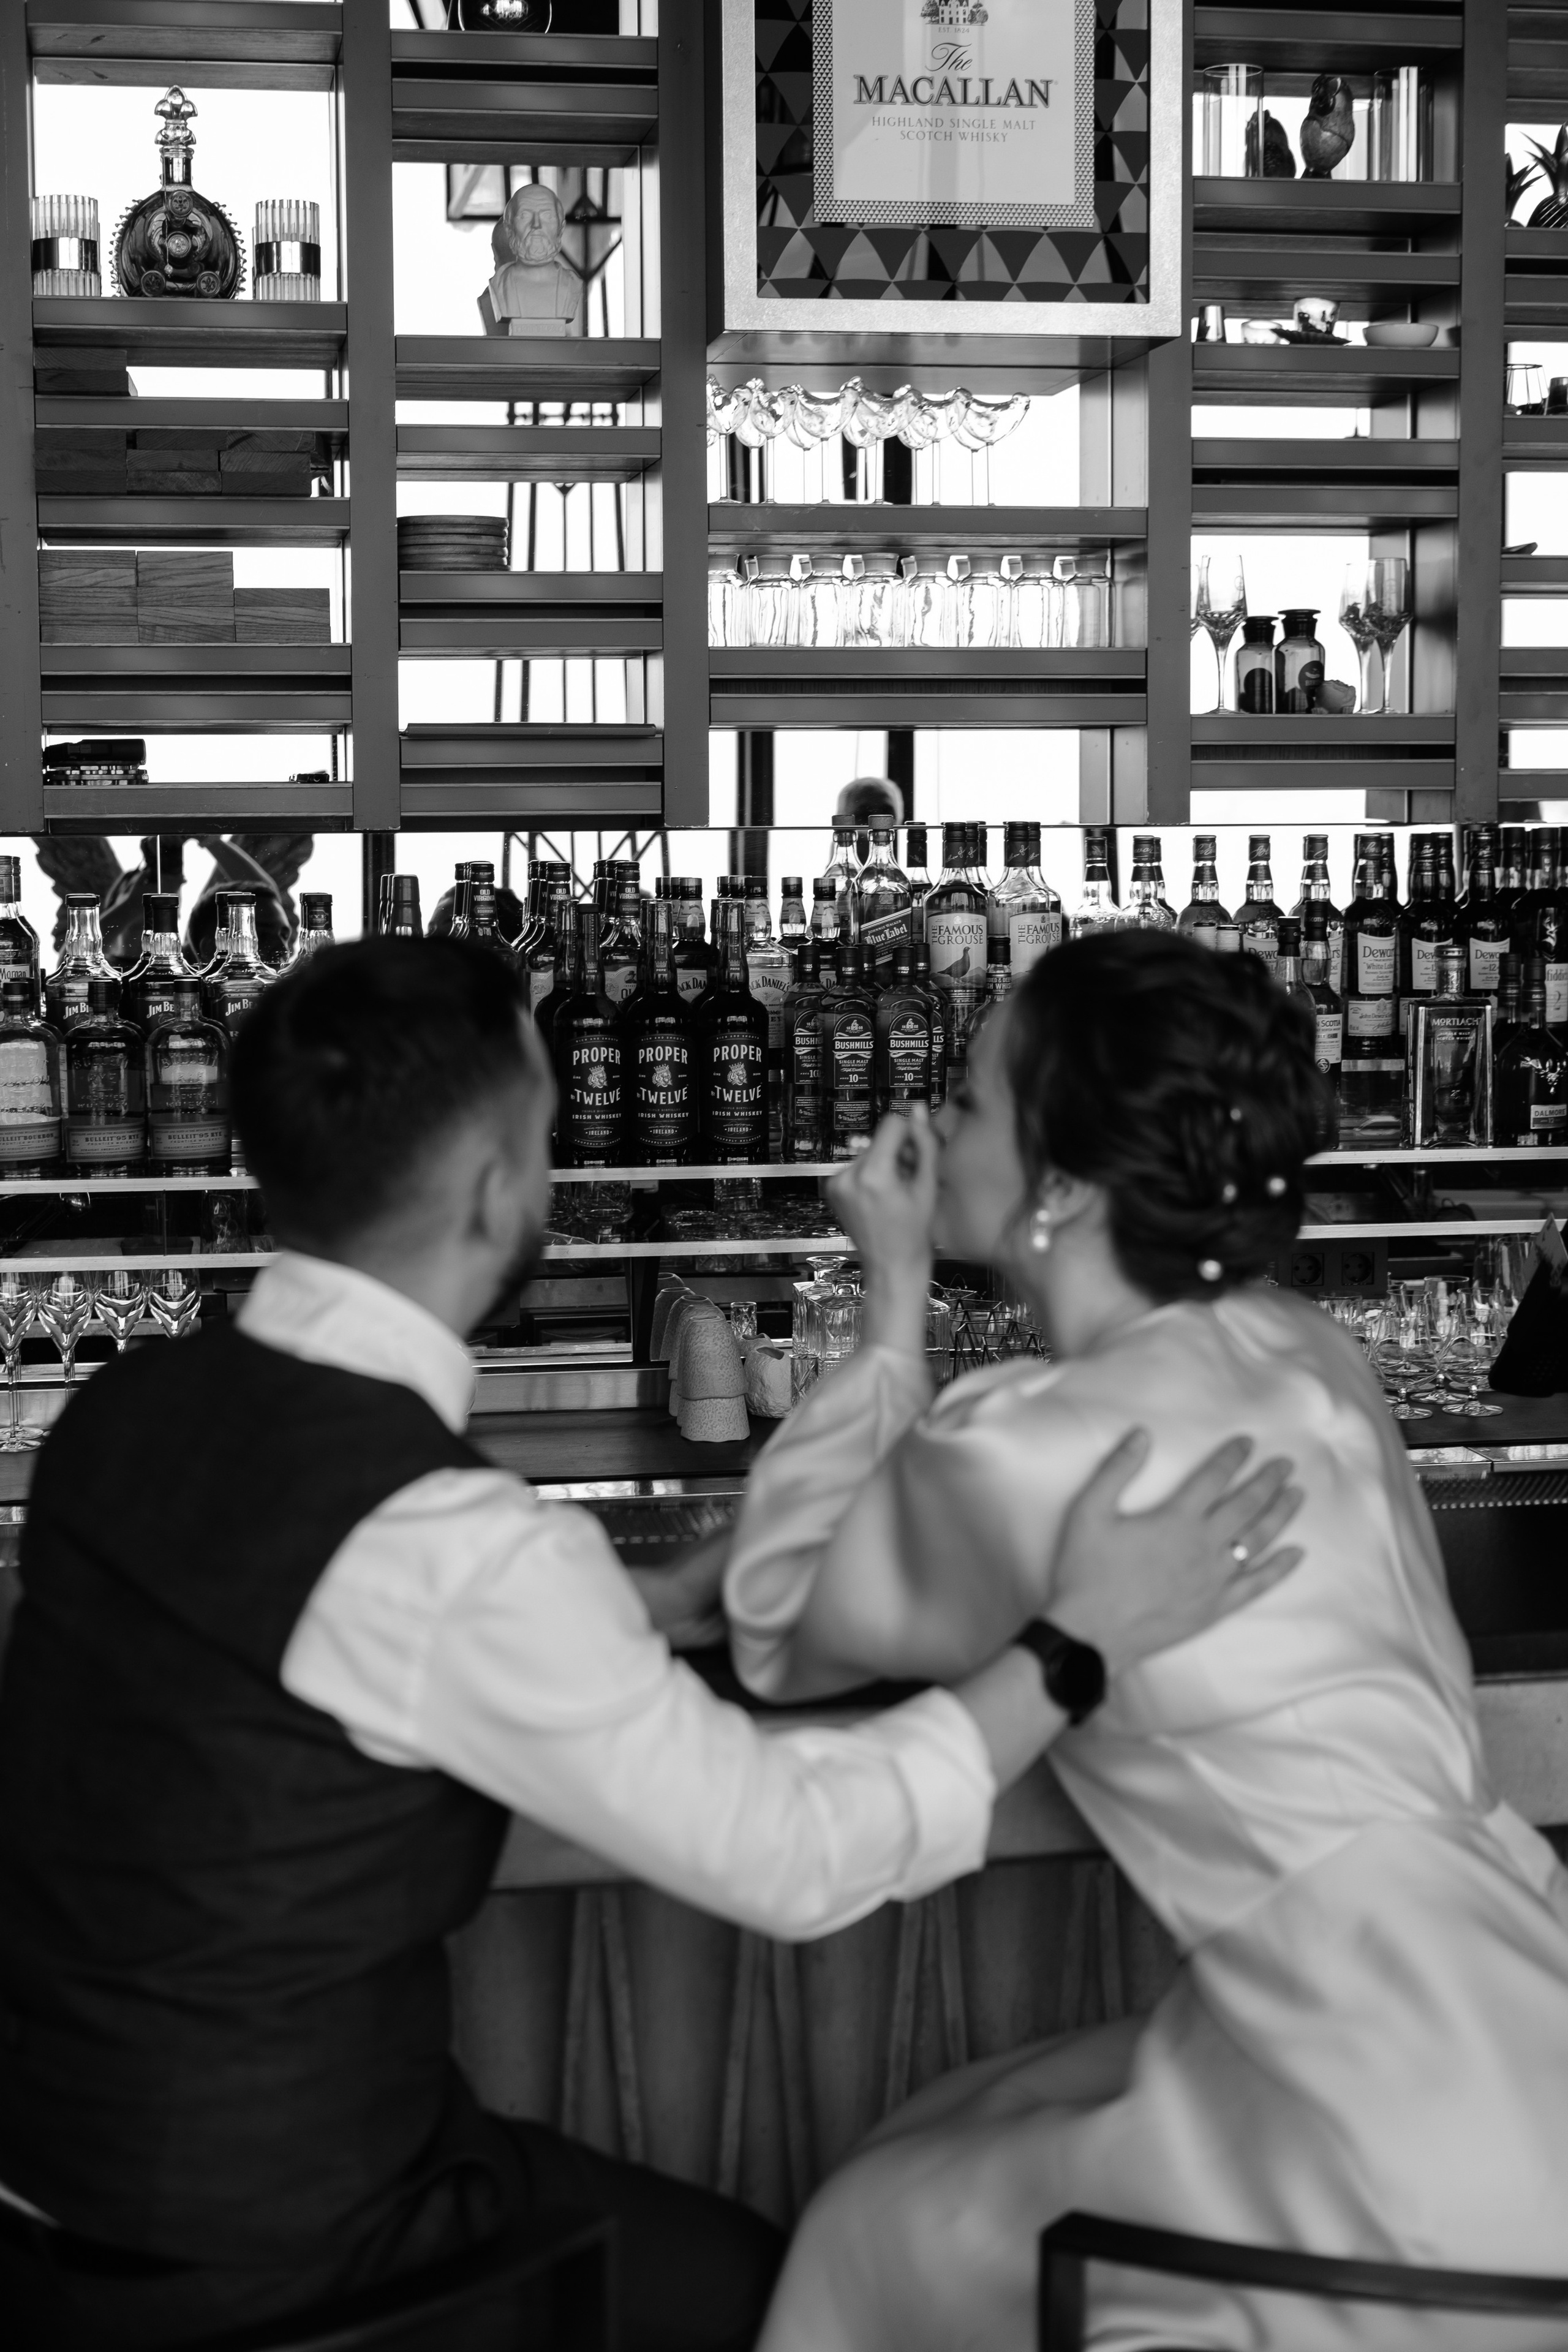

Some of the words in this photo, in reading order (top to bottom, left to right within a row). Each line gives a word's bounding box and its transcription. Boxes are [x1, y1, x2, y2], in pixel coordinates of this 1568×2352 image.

[925, 42, 973, 72] The
[853, 74, 1053, 109] MACALLAN
[872, 116, 944, 129] HIGHLAND
[950, 118, 997, 129] SINGLE
[1003, 120, 1036, 130] MALT
[900, 130, 952, 141] SCOTCH
[959, 131, 1008, 143] WHISKY
[864, 933, 886, 944] Blue
[883, 923, 908, 940] Label
[938, 925, 983, 935] FAMOUS
[938, 935, 983, 944] GROUSE
[1362, 946, 1395, 958] Dewar
[1476, 949, 1499, 959] Dewa
[678, 981, 691, 992] ACK
[762, 976, 791, 993] DANIEL'S
[621, 989, 633, 1000] OL
[63, 1005, 79, 1020] JIM
[146, 1004, 163, 1019] JIM
[163, 1001, 175, 1012] BE
[225, 1002, 241, 1017] JIM
[835, 1041, 874, 1049] BUSHMILLS
[890, 1039, 929, 1048] BUSHMILLS
[573, 1047, 620, 1066] PROPER
[639, 1046, 688, 1064] PROPER
[714, 1044, 761, 1063] PROPER
[848, 1074, 859, 1083] 10
[903, 1072, 914, 1081] 10
[574, 1087, 620, 1106] TWELVE
[639, 1087, 688, 1105] TWELVE
[714, 1085, 761, 1102] TWELVE
